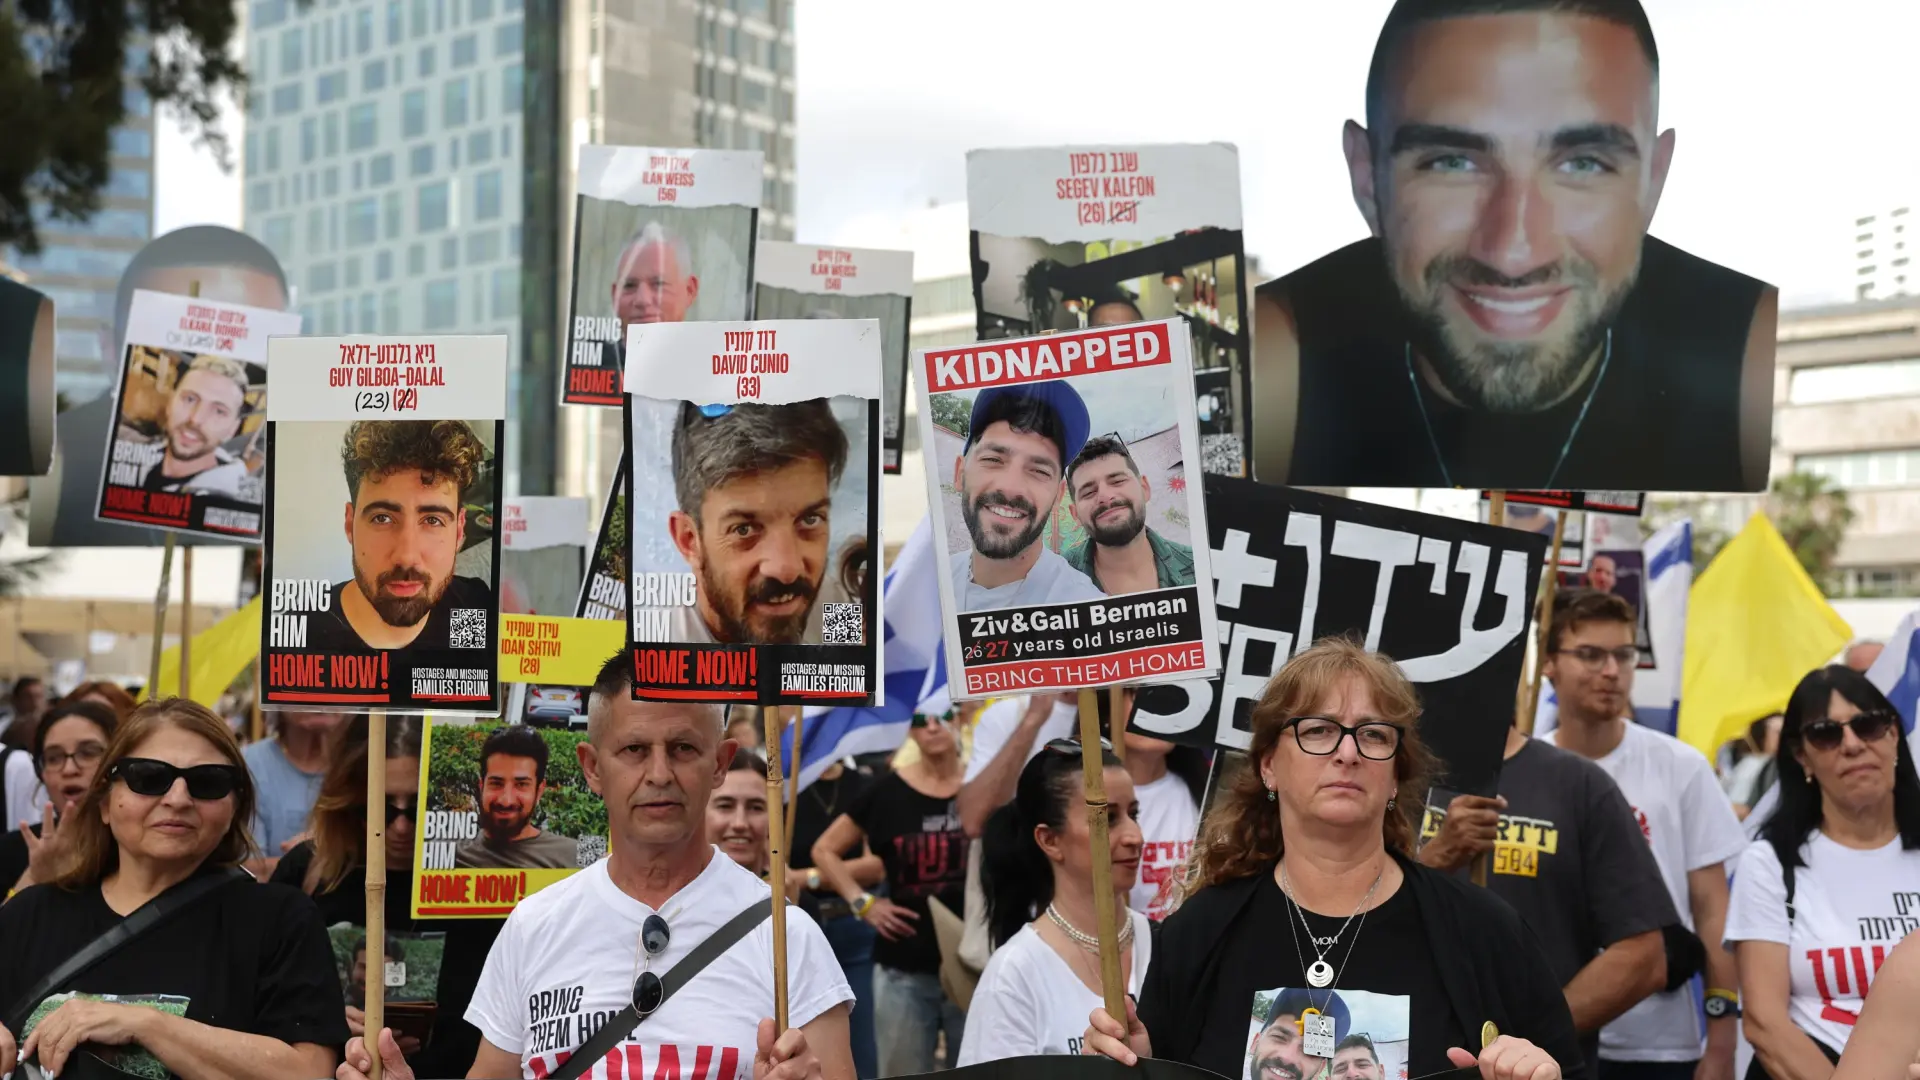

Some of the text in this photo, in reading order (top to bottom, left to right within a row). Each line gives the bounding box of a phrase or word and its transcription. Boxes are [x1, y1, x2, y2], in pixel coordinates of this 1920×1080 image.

[1110, 152, 1138, 173] שגב
[642, 171, 696, 187] ILAN WEISS
[1056, 176, 1155, 200] SEGEV KALFON
[657, 187, 677, 203] (56)
[1078, 201, 1105, 226] (26)
[573, 316, 622, 342] BRING
[724, 330, 776, 353] דוד קוניו
[340, 343, 436, 364] גיא גלבוע-דלאל
[572, 341, 603, 366] HIM
[712, 353, 789, 375] DAVID CUNIO
[934, 330, 1161, 387] KIDNAPPED
[329, 366, 445, 387] GUY GILBOA-DALAL
[570, 368, 615, 394] HOME
[737, 376, 761, 399] (33)
[355, 391, 390, 412] (23)
[109, 461, 140, 487] HIM
[106, 486, 147, 512] HOME
[149, 492, 192, 519] NOW!
[271, 578, 331, 612] BRING
[588, 572, 626, 610] BRIN
[633, 572, 696, 607] BRING
[633, 609, 671, 643] HIM
[970, 597, 1188, 638] Ziv&Gali Berman
[270, 615, 308, 648] HIM
[538, 622, 559, 639] עידן
[985, 640, 1009, 658] 27
[1013, 639, 1065, 657] years
[1072, 632, 1102, 650] old
[1110, 622, 1180, 645] Israelis
[501, 639, 561, 657] IDAN SHTIVI
[269, 652, 389, 690] HOME NOW!
[412, 668, 489, 680] HOSTAGES AND MISSING
[520, 656, 540, 676] (28)
[634, 647, 758, 687] HOME NOW!
[781, 663, 865, 676] HOSTAGES AND MISSING
[967, 649, 1204, 692] BRING THEM HOME
[412, 679, 489, 696] FAMILIES FORUM
[781, 675, 865, 693] FAMILIES FORUM
[424, 810, 478, 840] BRING
[422, 841, 457, 870] HIM
[420, 871, 526, 904] HOME NOW!
[1313, 936, 1338, 945] MOM
[529, 985, 584, 1024] BRING
[530, 1017, 571, 1054] THEM
